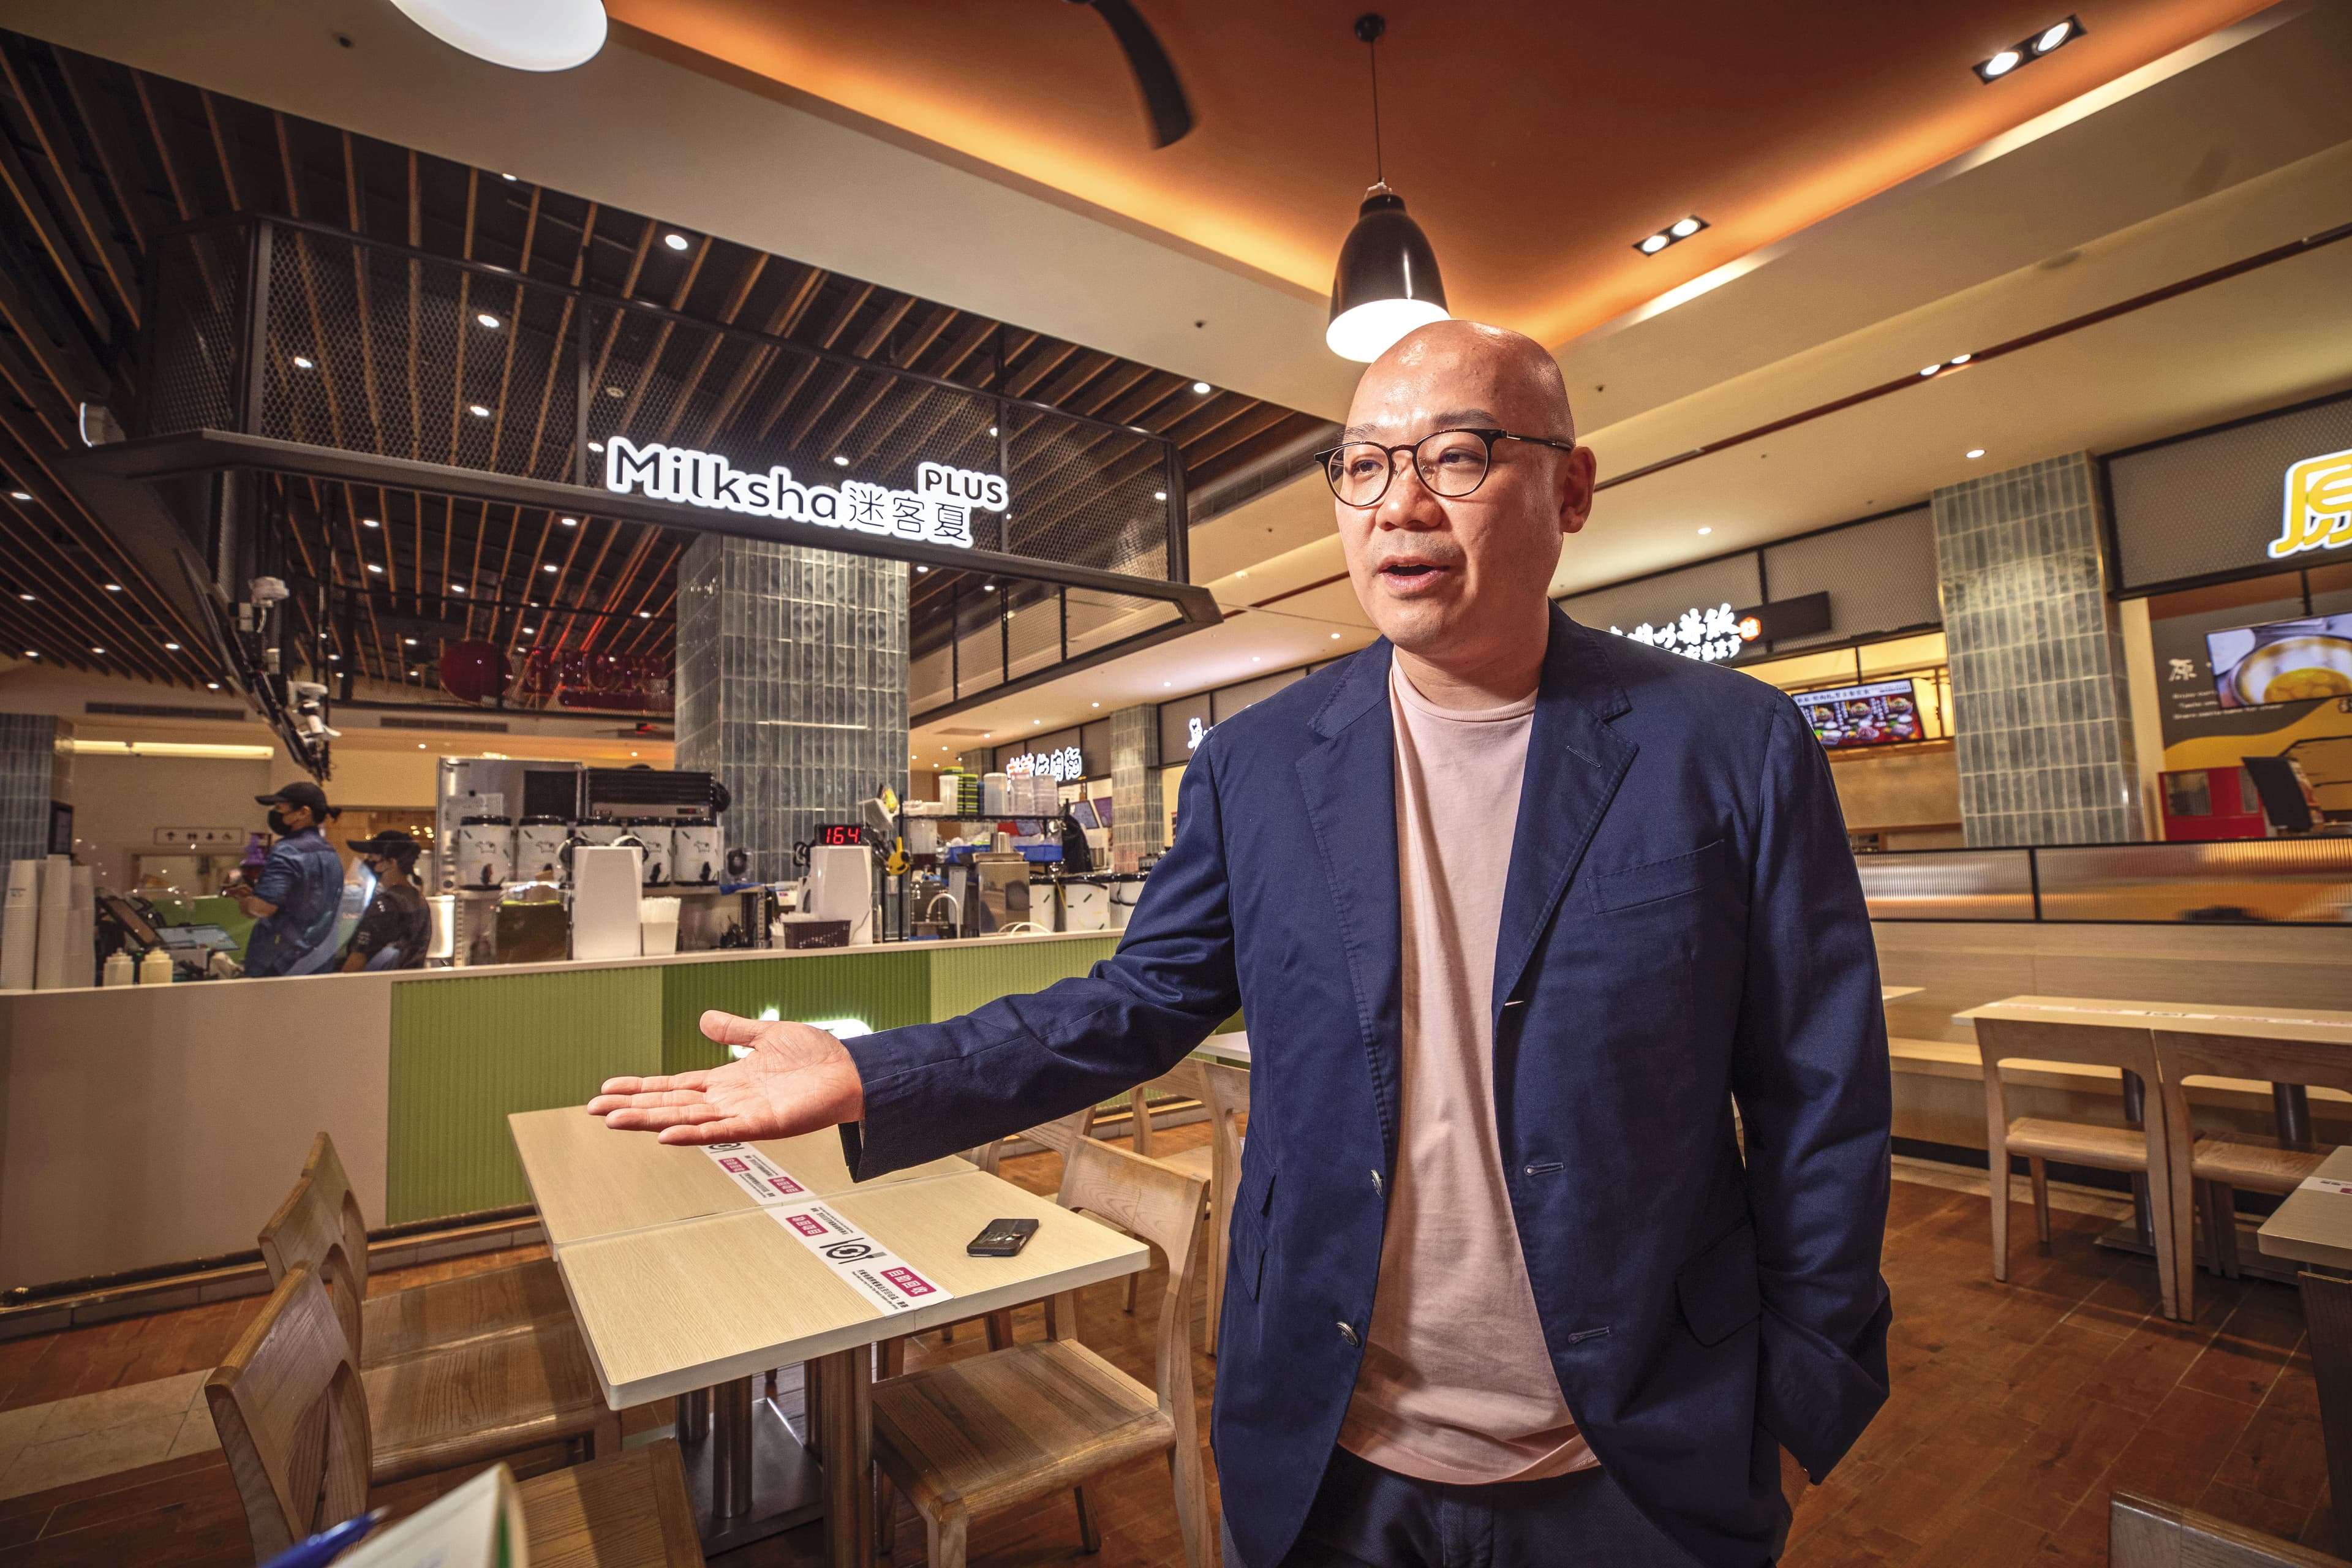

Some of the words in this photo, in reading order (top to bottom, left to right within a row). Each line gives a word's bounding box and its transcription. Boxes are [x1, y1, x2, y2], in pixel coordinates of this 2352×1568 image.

[616, 445, 837, 521] Milksha
[925, 469, 1003, 505] PLUS
[849, 487, 968, 542] 迷客夏
[826, 826, 860, 845] 164
[887, 1269, 929, 1295] 自助回收
